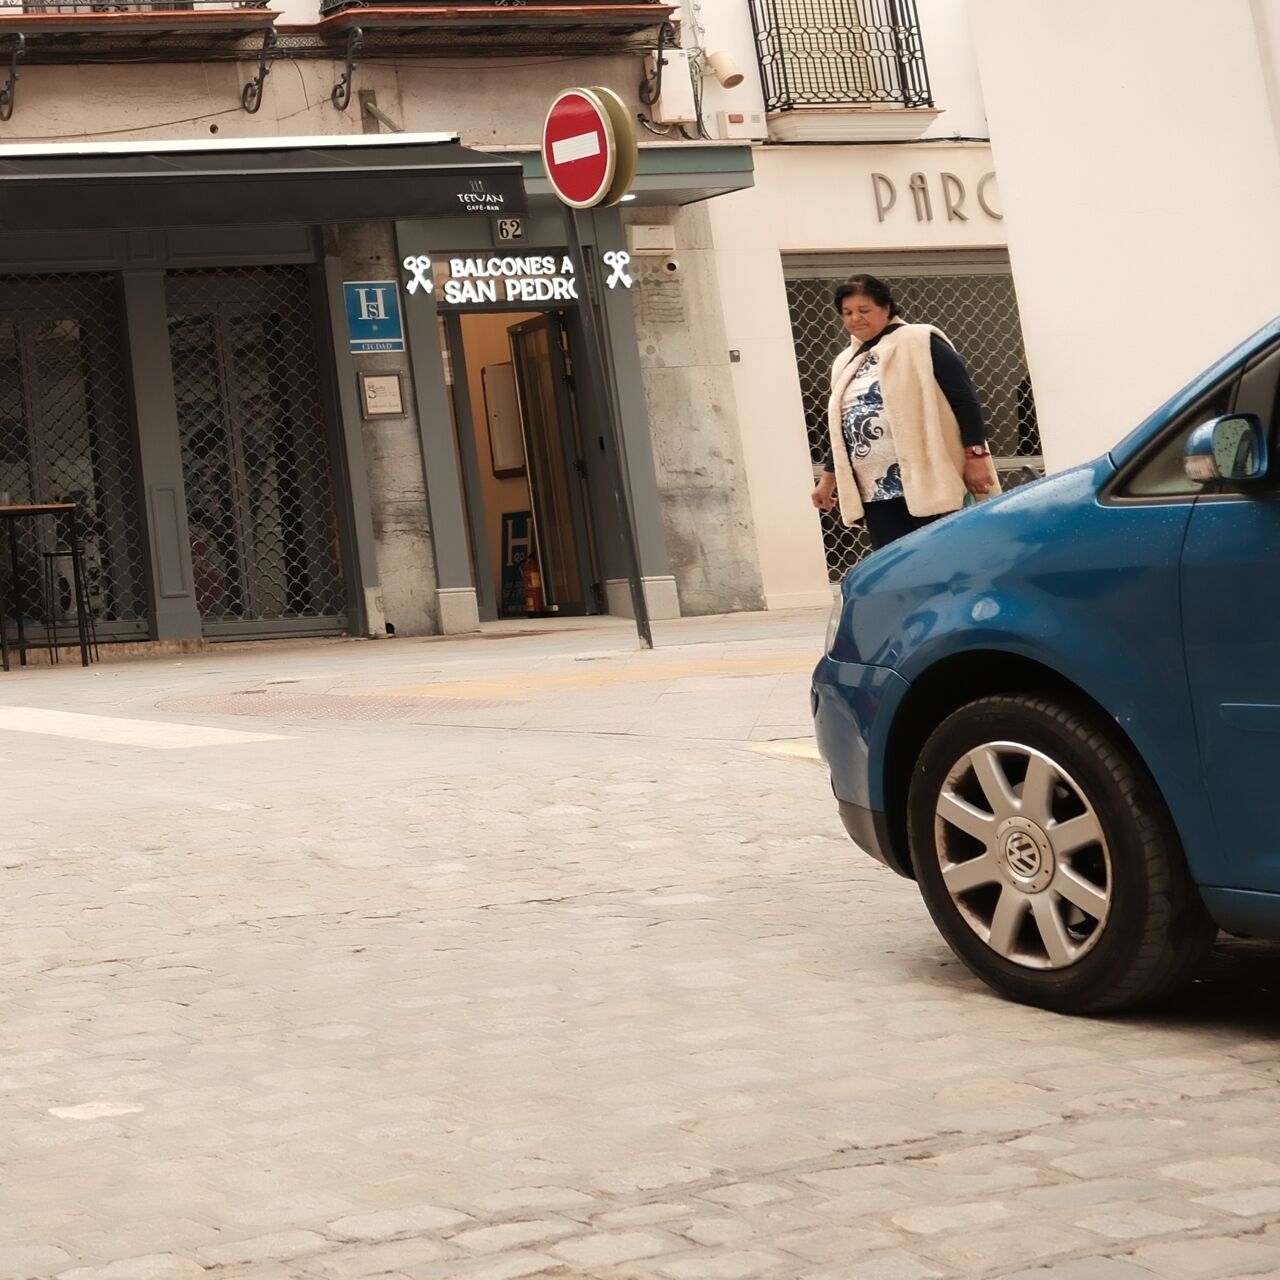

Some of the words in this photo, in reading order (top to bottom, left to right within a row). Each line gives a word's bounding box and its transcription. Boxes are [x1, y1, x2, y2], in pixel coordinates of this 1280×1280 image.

[456, 193, 504, 203] TETUAN
[499, 219, 522, 239] 62
[450, 256, 556, 278] BALCONES
[561, 255, 574, 274] A
[444, 279, 497, 304] SAN
[361, 342, 393, 350] CIUDAD
